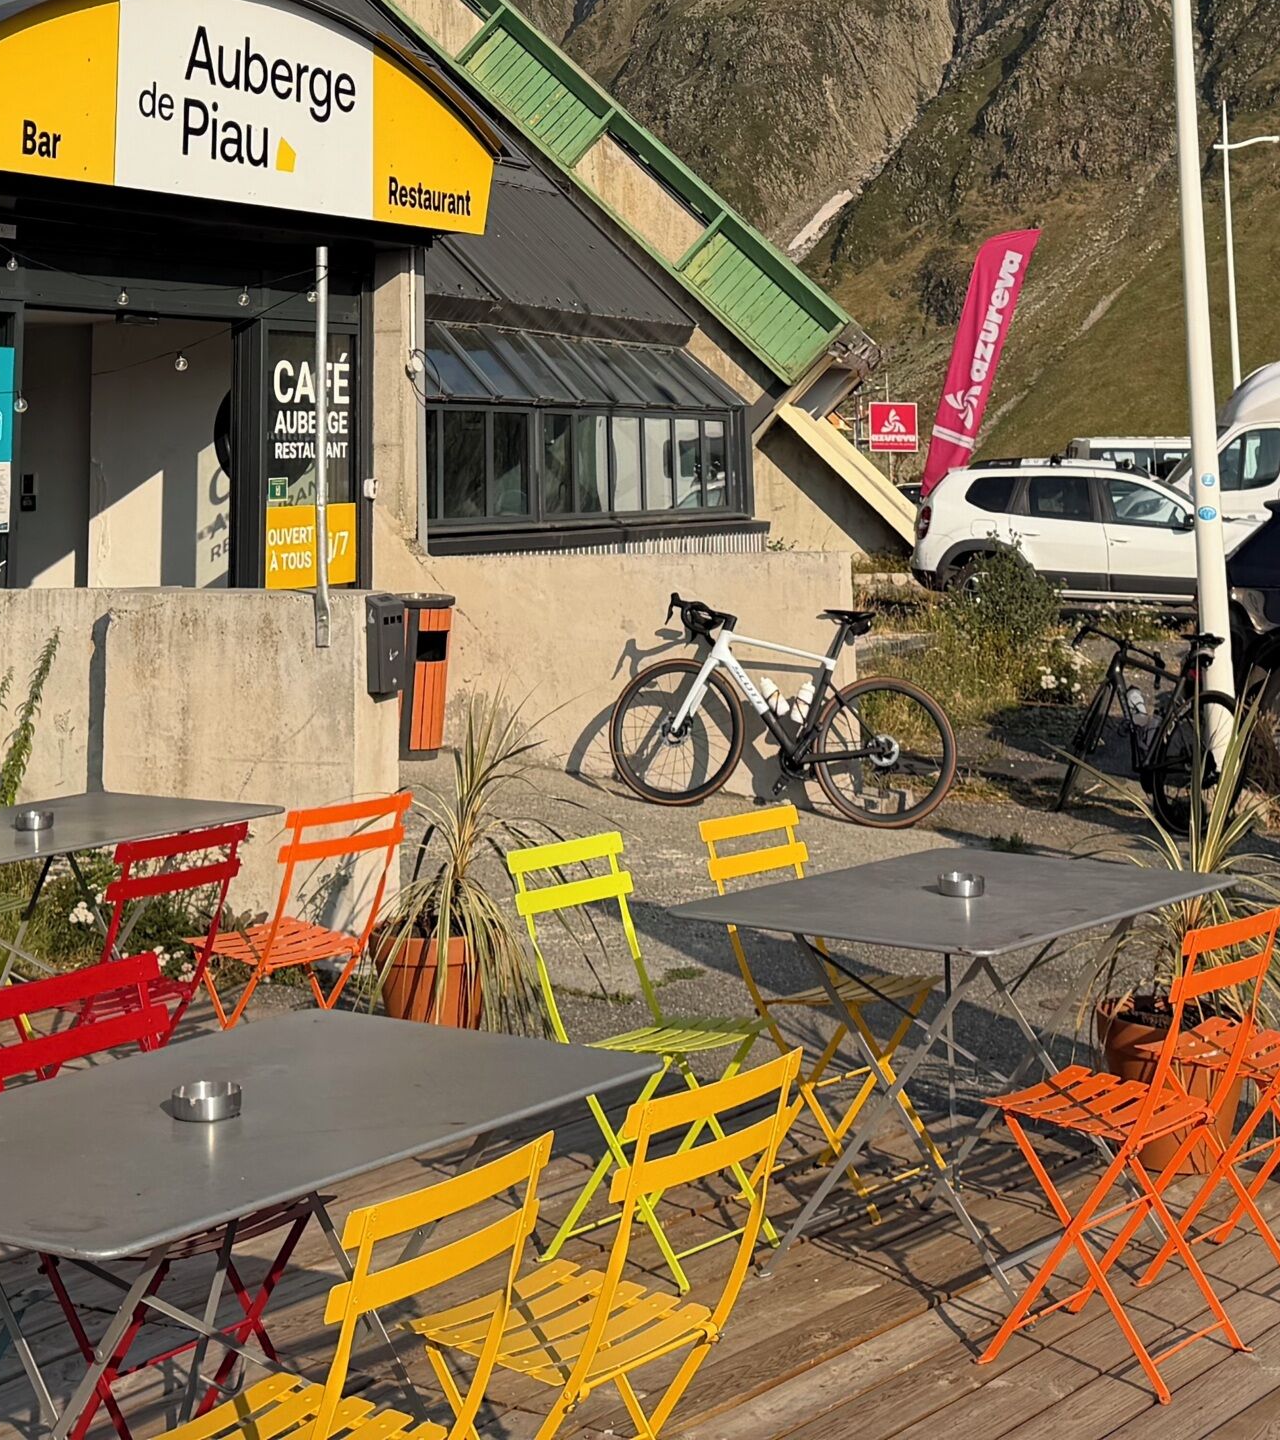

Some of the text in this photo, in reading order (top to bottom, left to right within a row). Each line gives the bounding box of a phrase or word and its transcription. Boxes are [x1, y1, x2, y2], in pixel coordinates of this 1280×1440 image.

[185, 25, 357, 123] Auberge
[21, 118, 62, 160] Bar
[138, 81, 268, 169] de Piau
[387, 176, 472, 218] Restaurant
[970, 249, 1023, 383] azureva
[274, 410, 349, 434] AUBEGE
[274, 441, 349, 460] RESTAUANT
[268, 526, 314, 547] OUVERT
[269, 549, 312, 572] À TOUS
